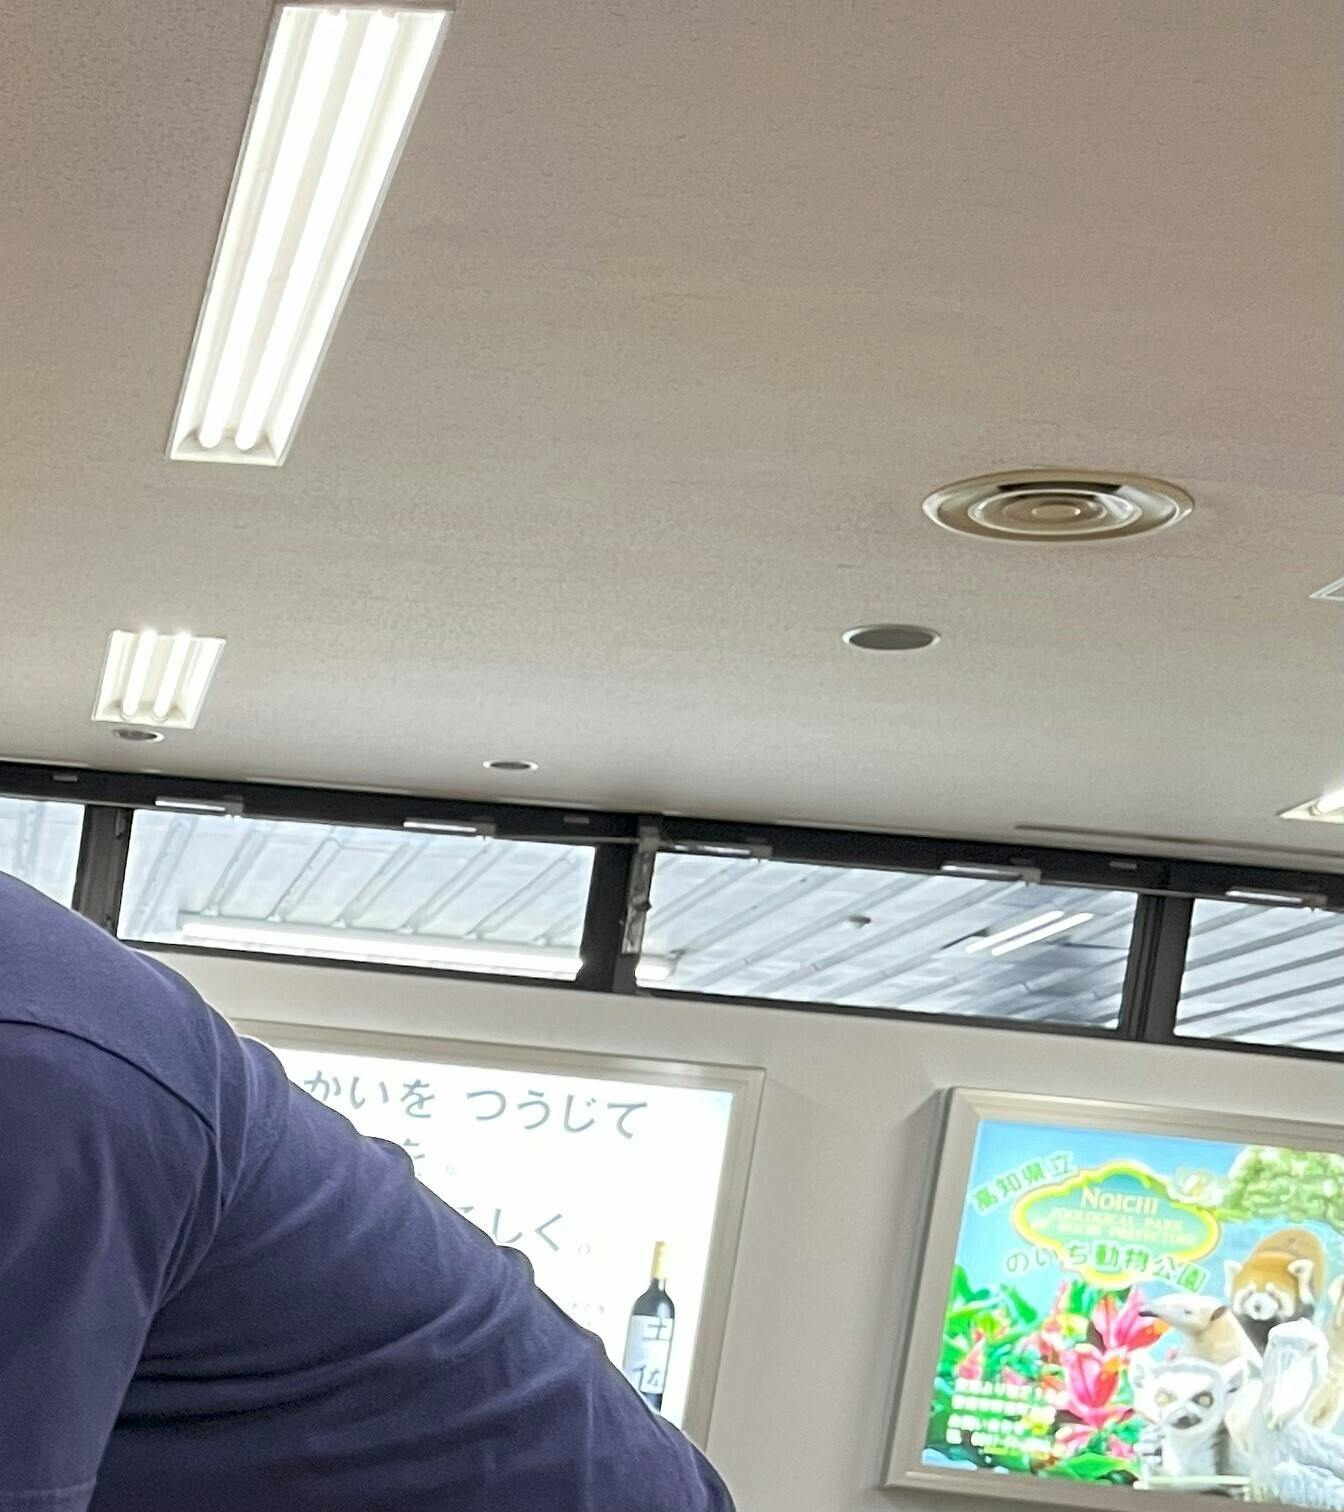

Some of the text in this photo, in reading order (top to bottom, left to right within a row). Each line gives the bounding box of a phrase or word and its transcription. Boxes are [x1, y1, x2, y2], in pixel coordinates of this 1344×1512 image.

[304, 1070, 648, 1140] かいを つうじて
[1006, 1243, 1205, 1294] のいち動物公園
